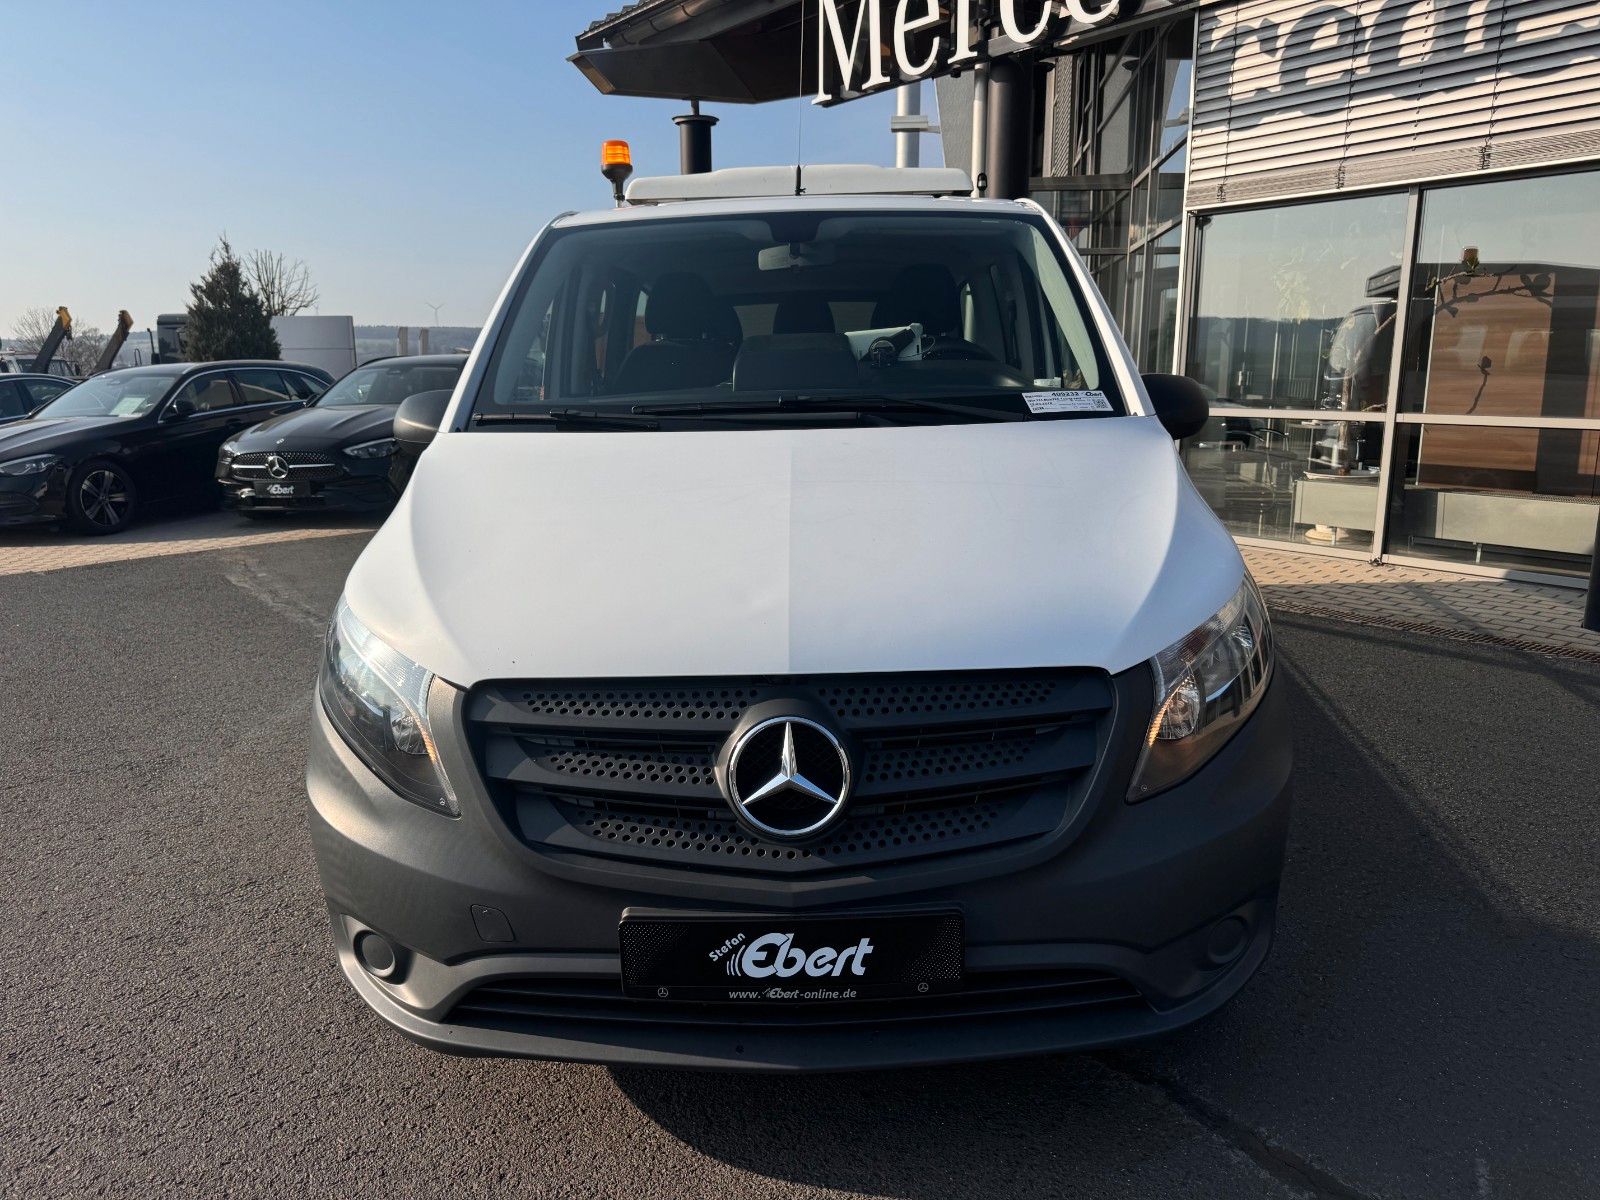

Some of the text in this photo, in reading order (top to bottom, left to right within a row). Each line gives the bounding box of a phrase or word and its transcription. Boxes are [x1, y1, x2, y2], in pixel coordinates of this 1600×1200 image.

[271, 484, 295, 495] Ebert
[708, 931, 874, 978] Stefan Ebert
